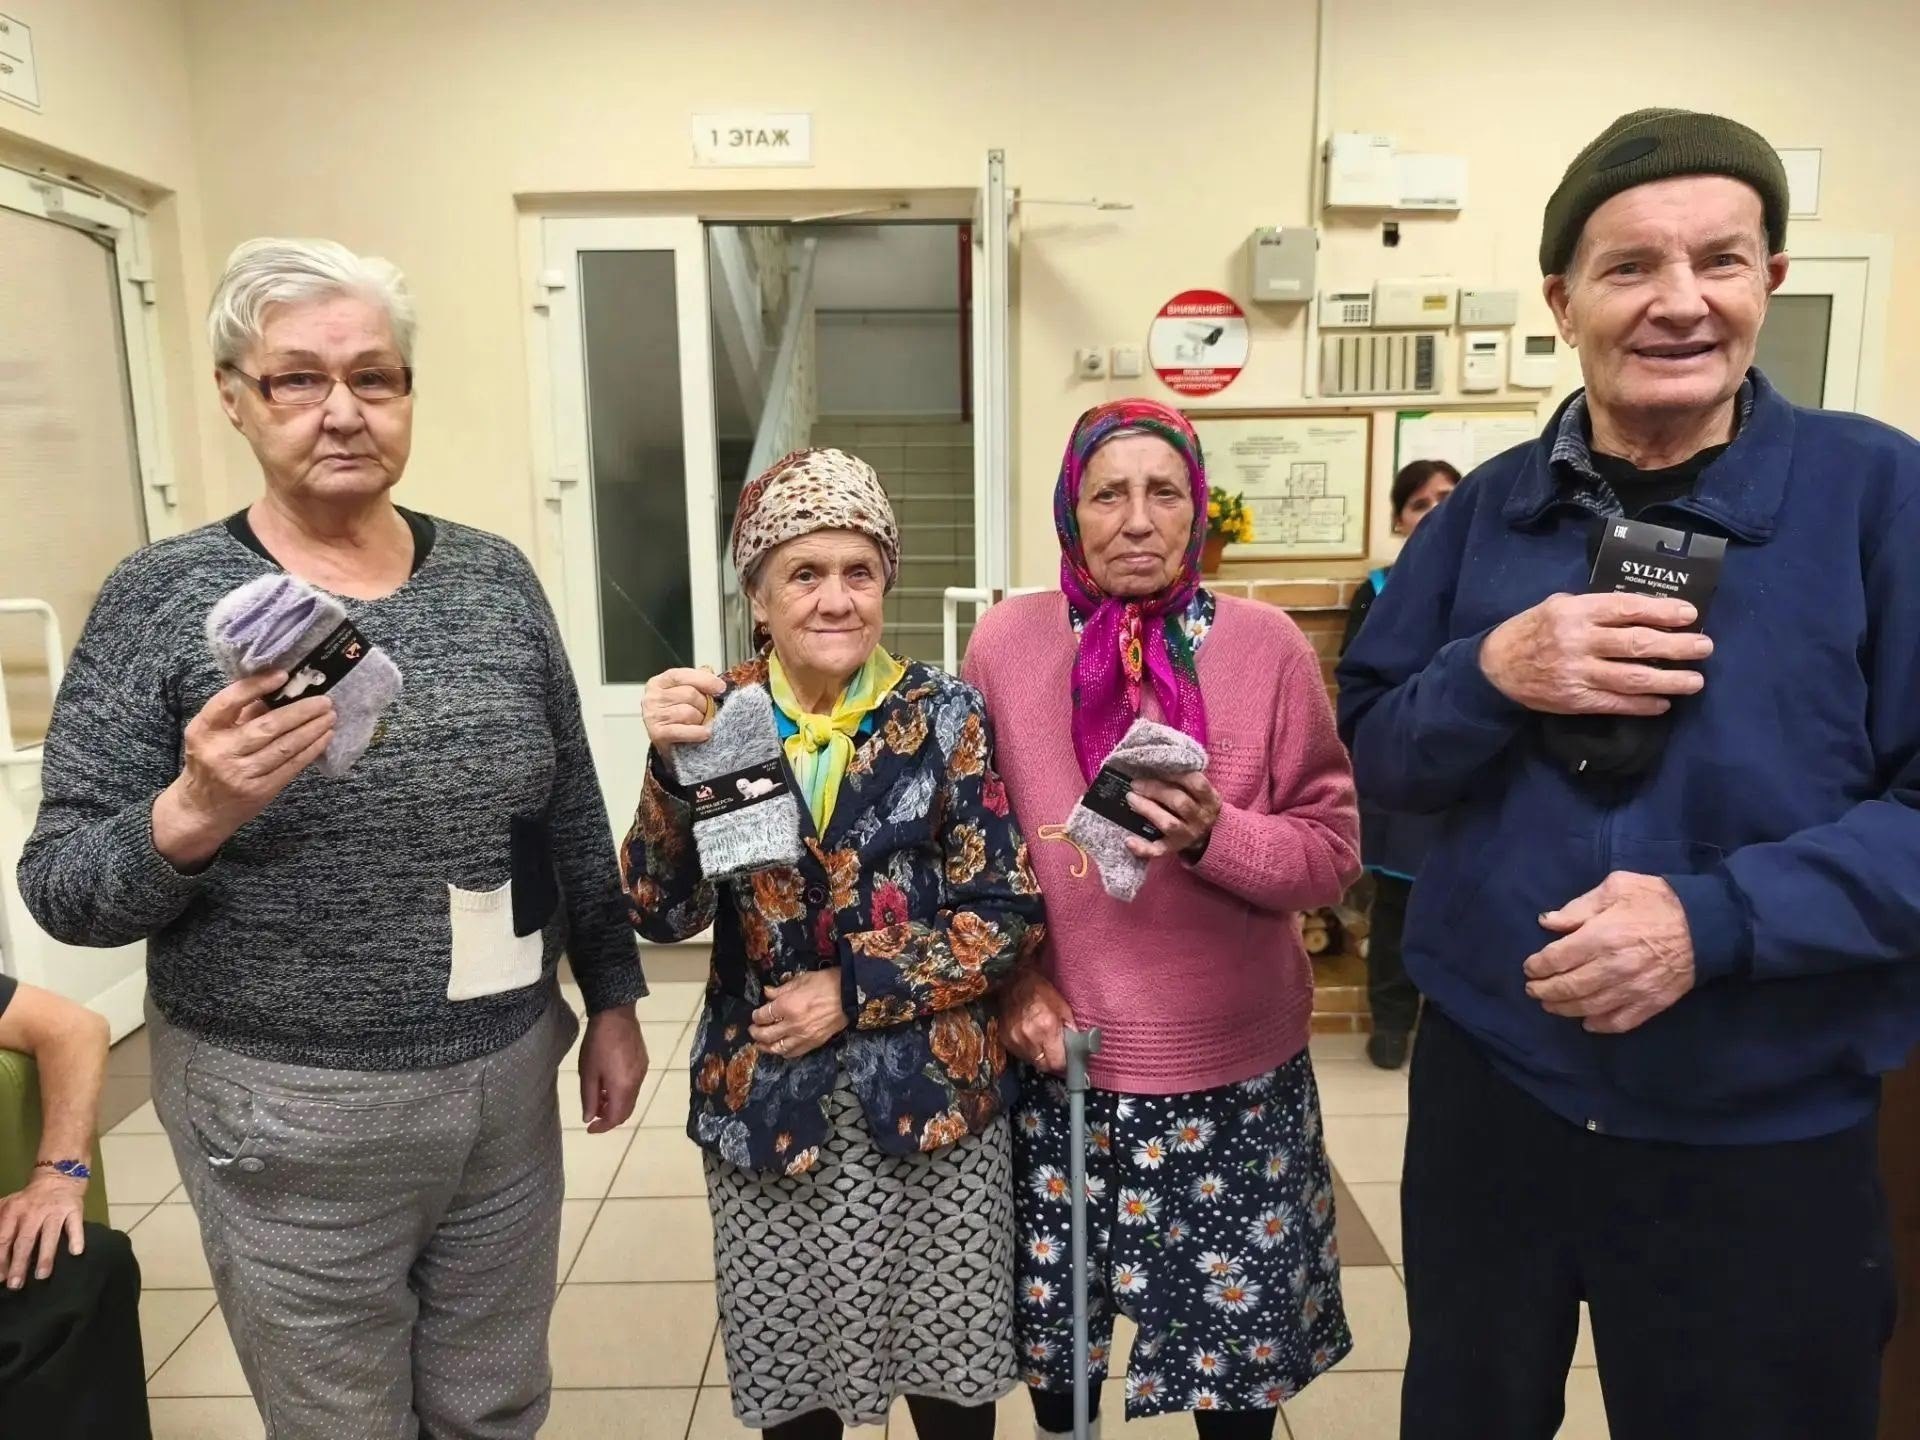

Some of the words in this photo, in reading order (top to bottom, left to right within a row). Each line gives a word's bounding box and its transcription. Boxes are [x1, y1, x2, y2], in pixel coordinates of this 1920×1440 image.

[711, 129, 719, 147] 1
[728, 128, 790, 147] ЭТАЖ
[1621, 560, 1690, 585] SYLTAN
